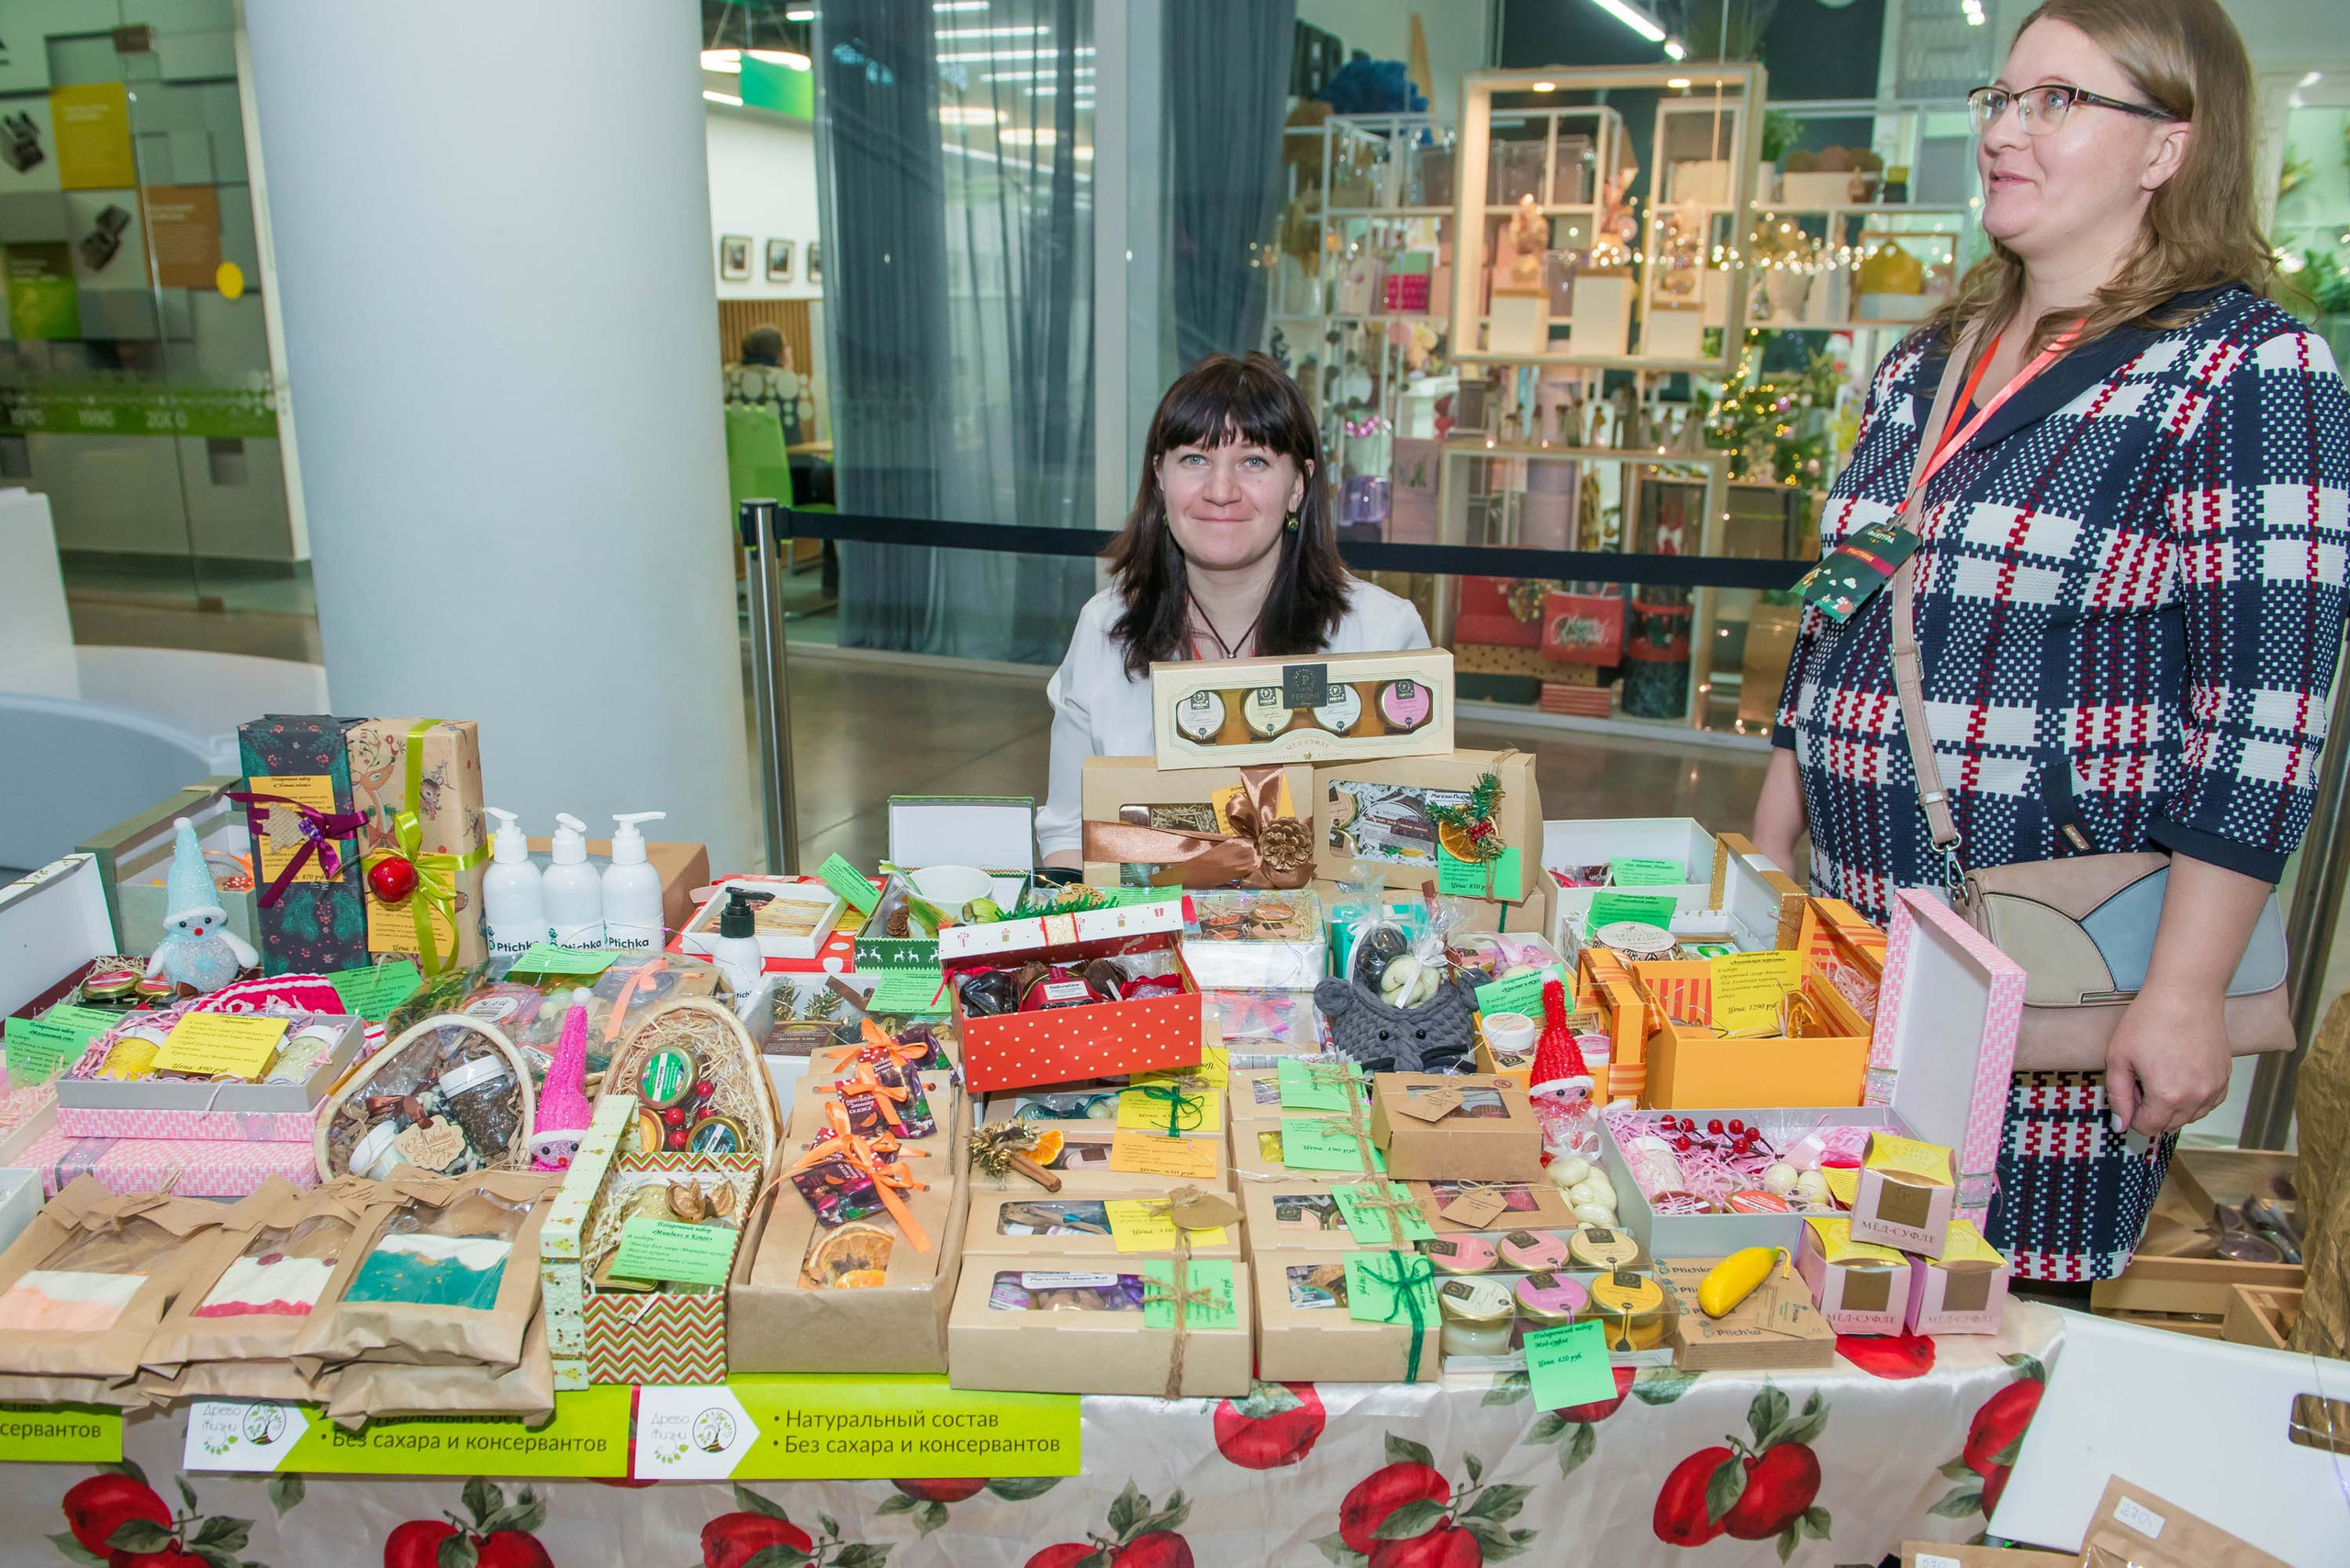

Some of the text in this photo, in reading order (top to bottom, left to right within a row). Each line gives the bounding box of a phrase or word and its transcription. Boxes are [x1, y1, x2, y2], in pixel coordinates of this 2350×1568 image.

[609, 935, 650, 948] Ptichka
[1749, 1003, 1765, 1012] 1290
[656, 1221, 694, 1231] Подарочный
[1534, 1327, 1573, 1339] Подарочный
[1538, 1359, 1555, 1368] Цена:
[202, 1405, 242, 1417] Древо
[651, 1412, 689, 1425] Древо
[787, 1409, 999, 1430] Натуральный состав
[332, 1429, 608, 1454] Без сахара и консервантов
[785, 1436, 1060, 1456] Без сахара и консервантов
